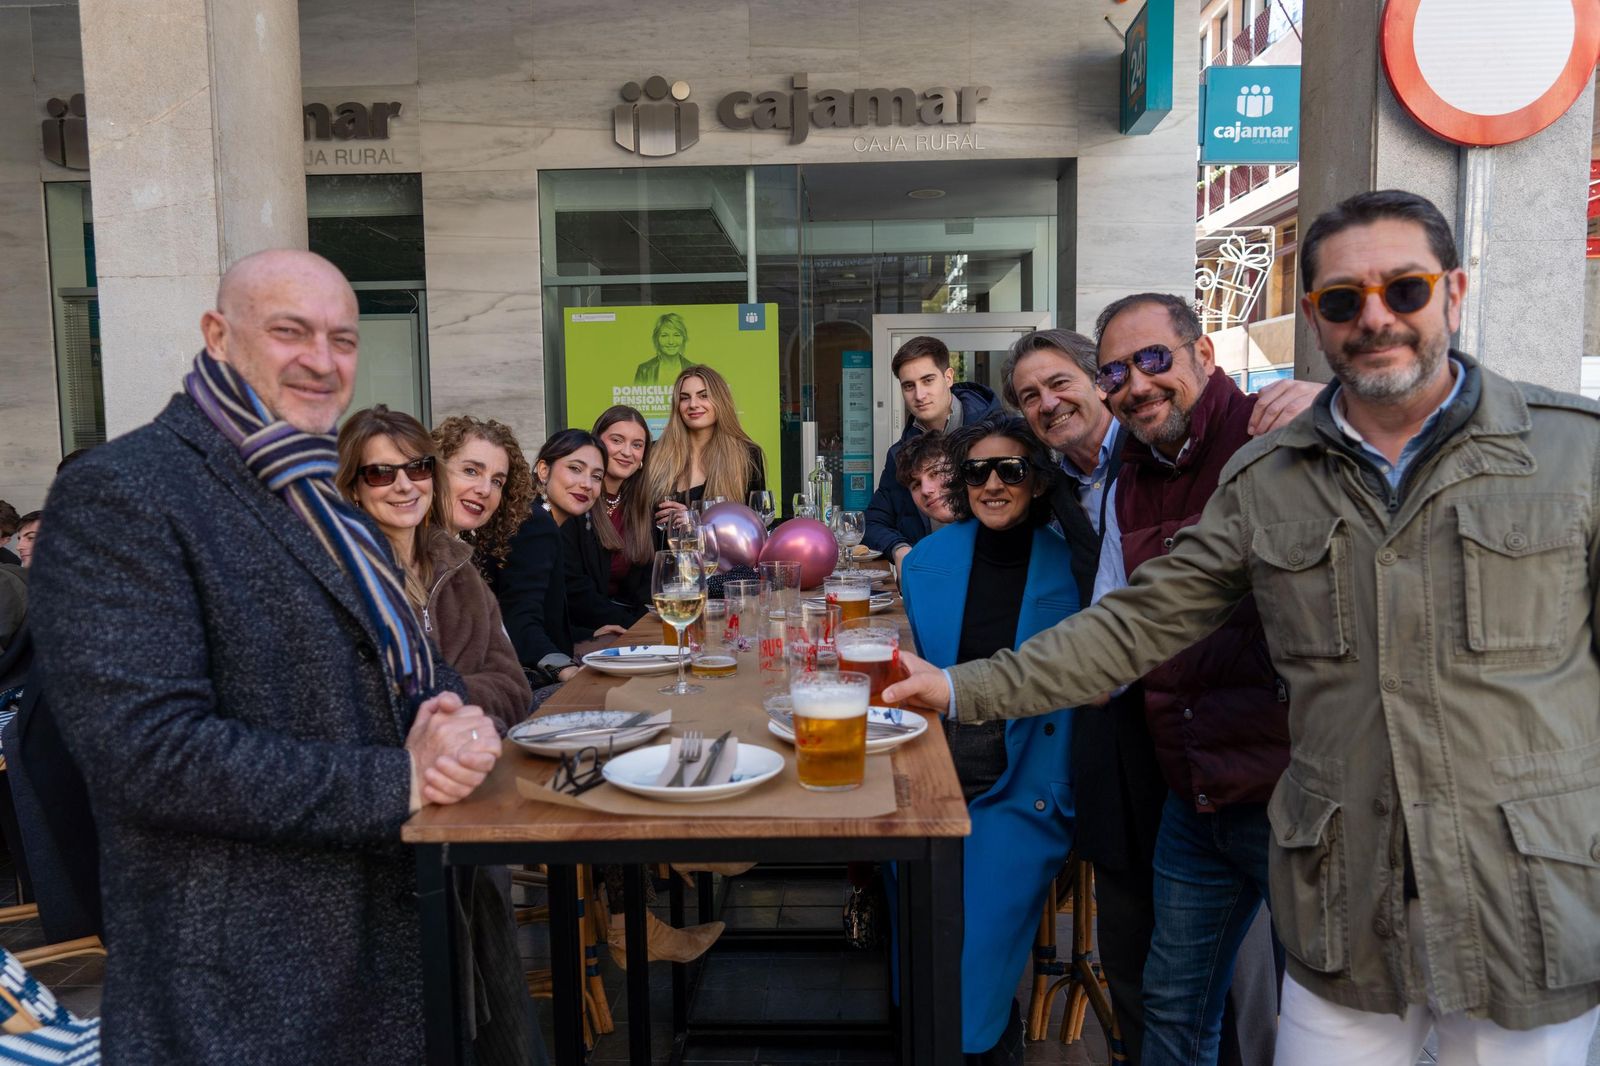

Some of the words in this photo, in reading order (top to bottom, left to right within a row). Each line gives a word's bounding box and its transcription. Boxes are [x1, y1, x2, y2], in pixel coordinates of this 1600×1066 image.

[716, 72, 992, 146] cajamar
[1213, 121, 1294, 144] cajamar
[853, 135, 908, 153] CAJA
[915, 133, 986, 152] RURAL
[304, 149, 328, 167] JA
[335, 147, 404, 166] RURAL
[651, 404, 671, 412] HAST
